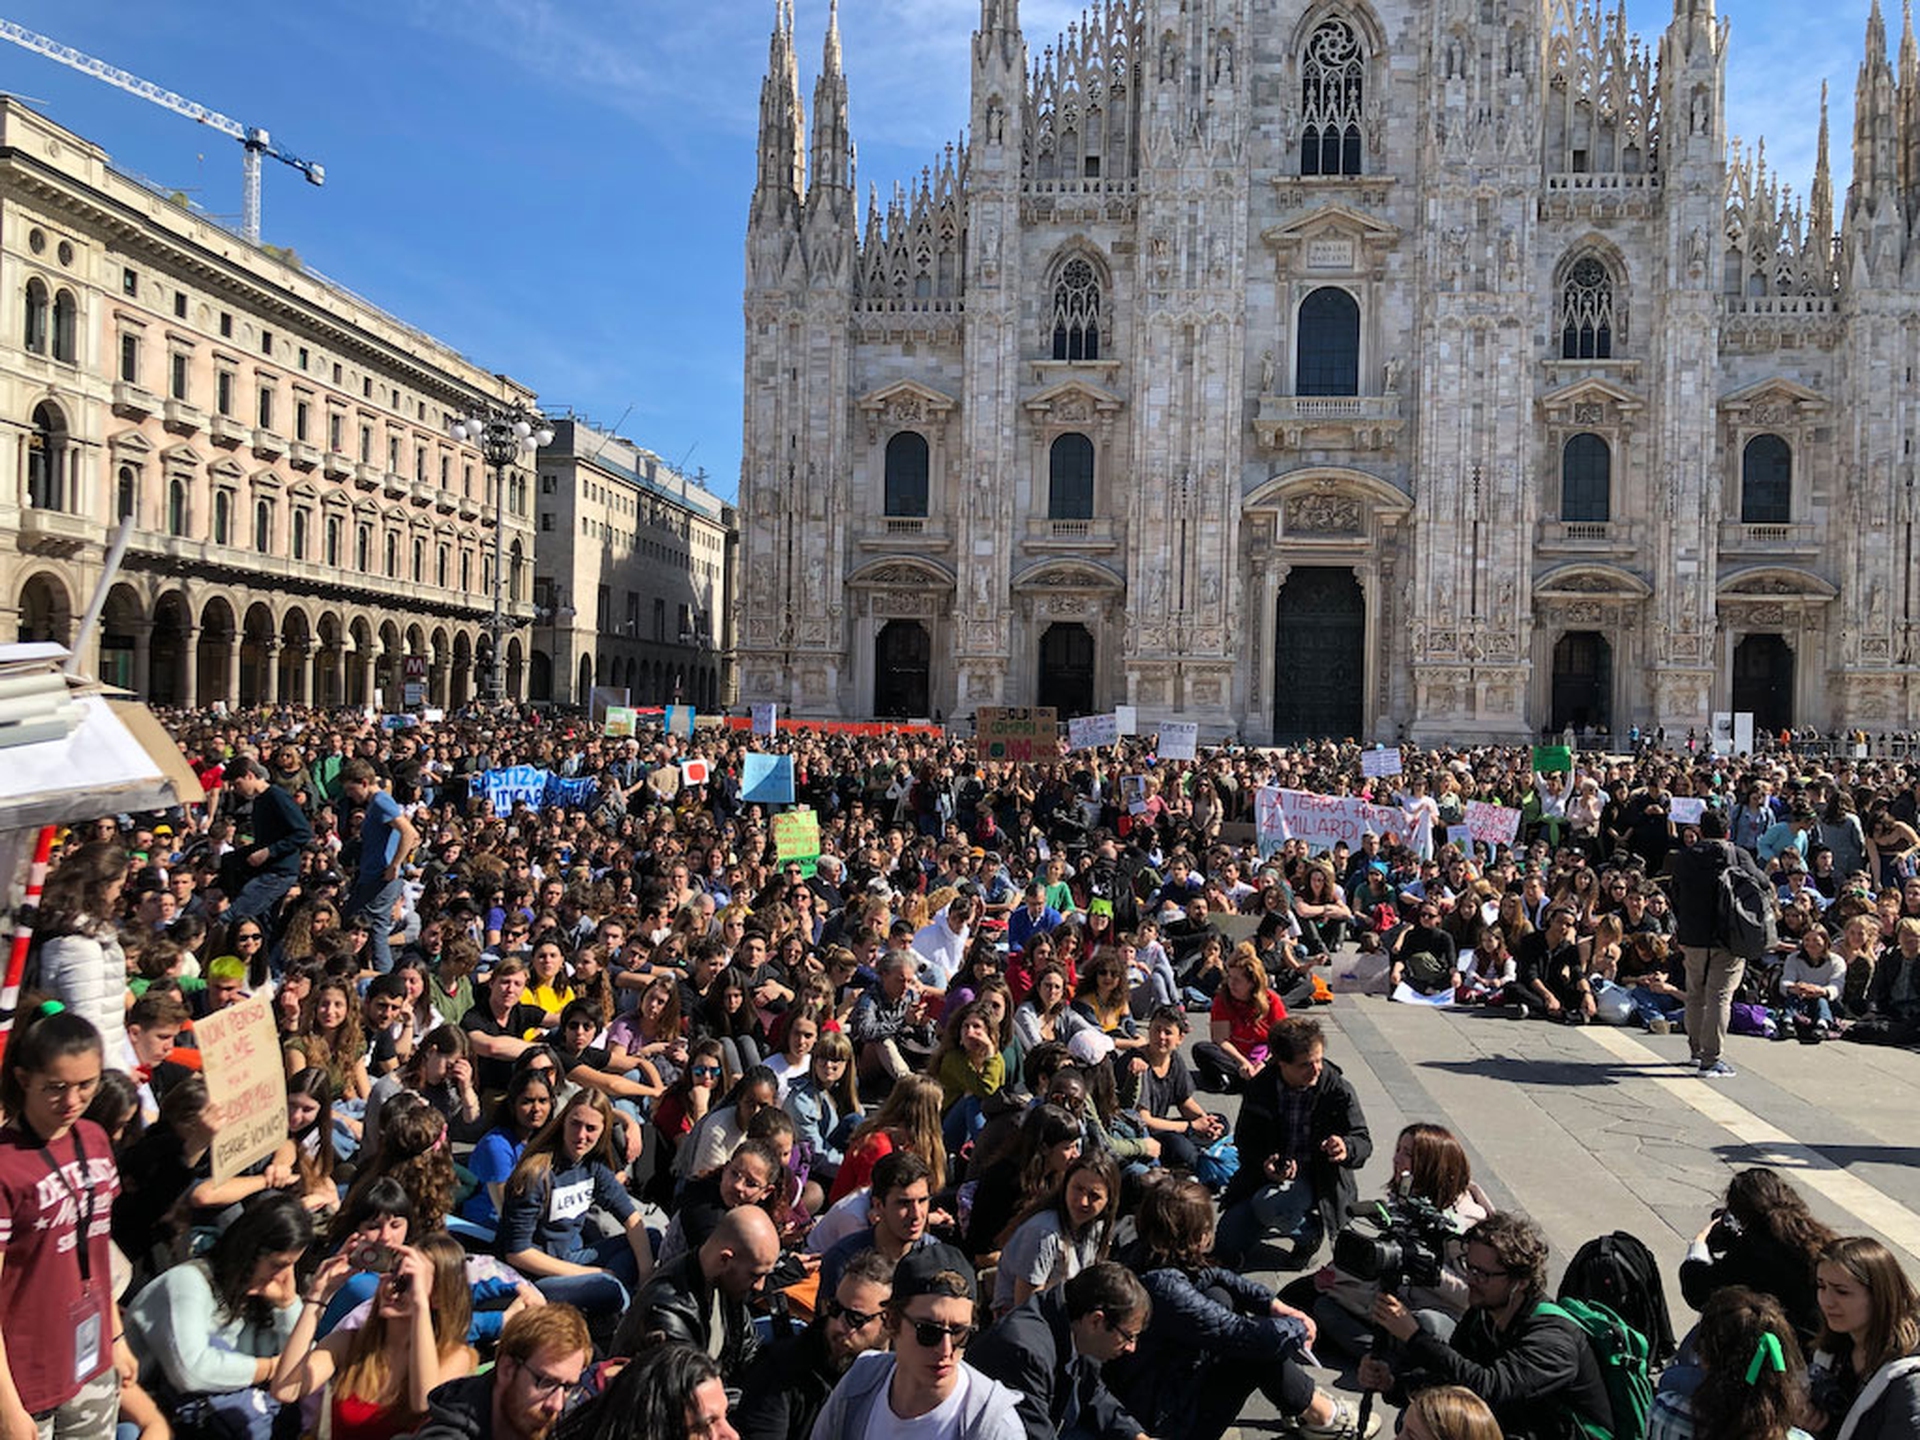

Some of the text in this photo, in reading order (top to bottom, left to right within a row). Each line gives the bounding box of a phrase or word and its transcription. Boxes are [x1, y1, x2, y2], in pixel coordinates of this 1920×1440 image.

[406, 658, 424, 673] M
[1261, 788, 1284, 810] LA
[1291, 793, 1346, 816] TERRA
[1262, 812, 1359, 840] 4 MILIARDI
[200, 1004, 265, 1046] NON PENSO
[233, 1033, 256, 1056] ME
